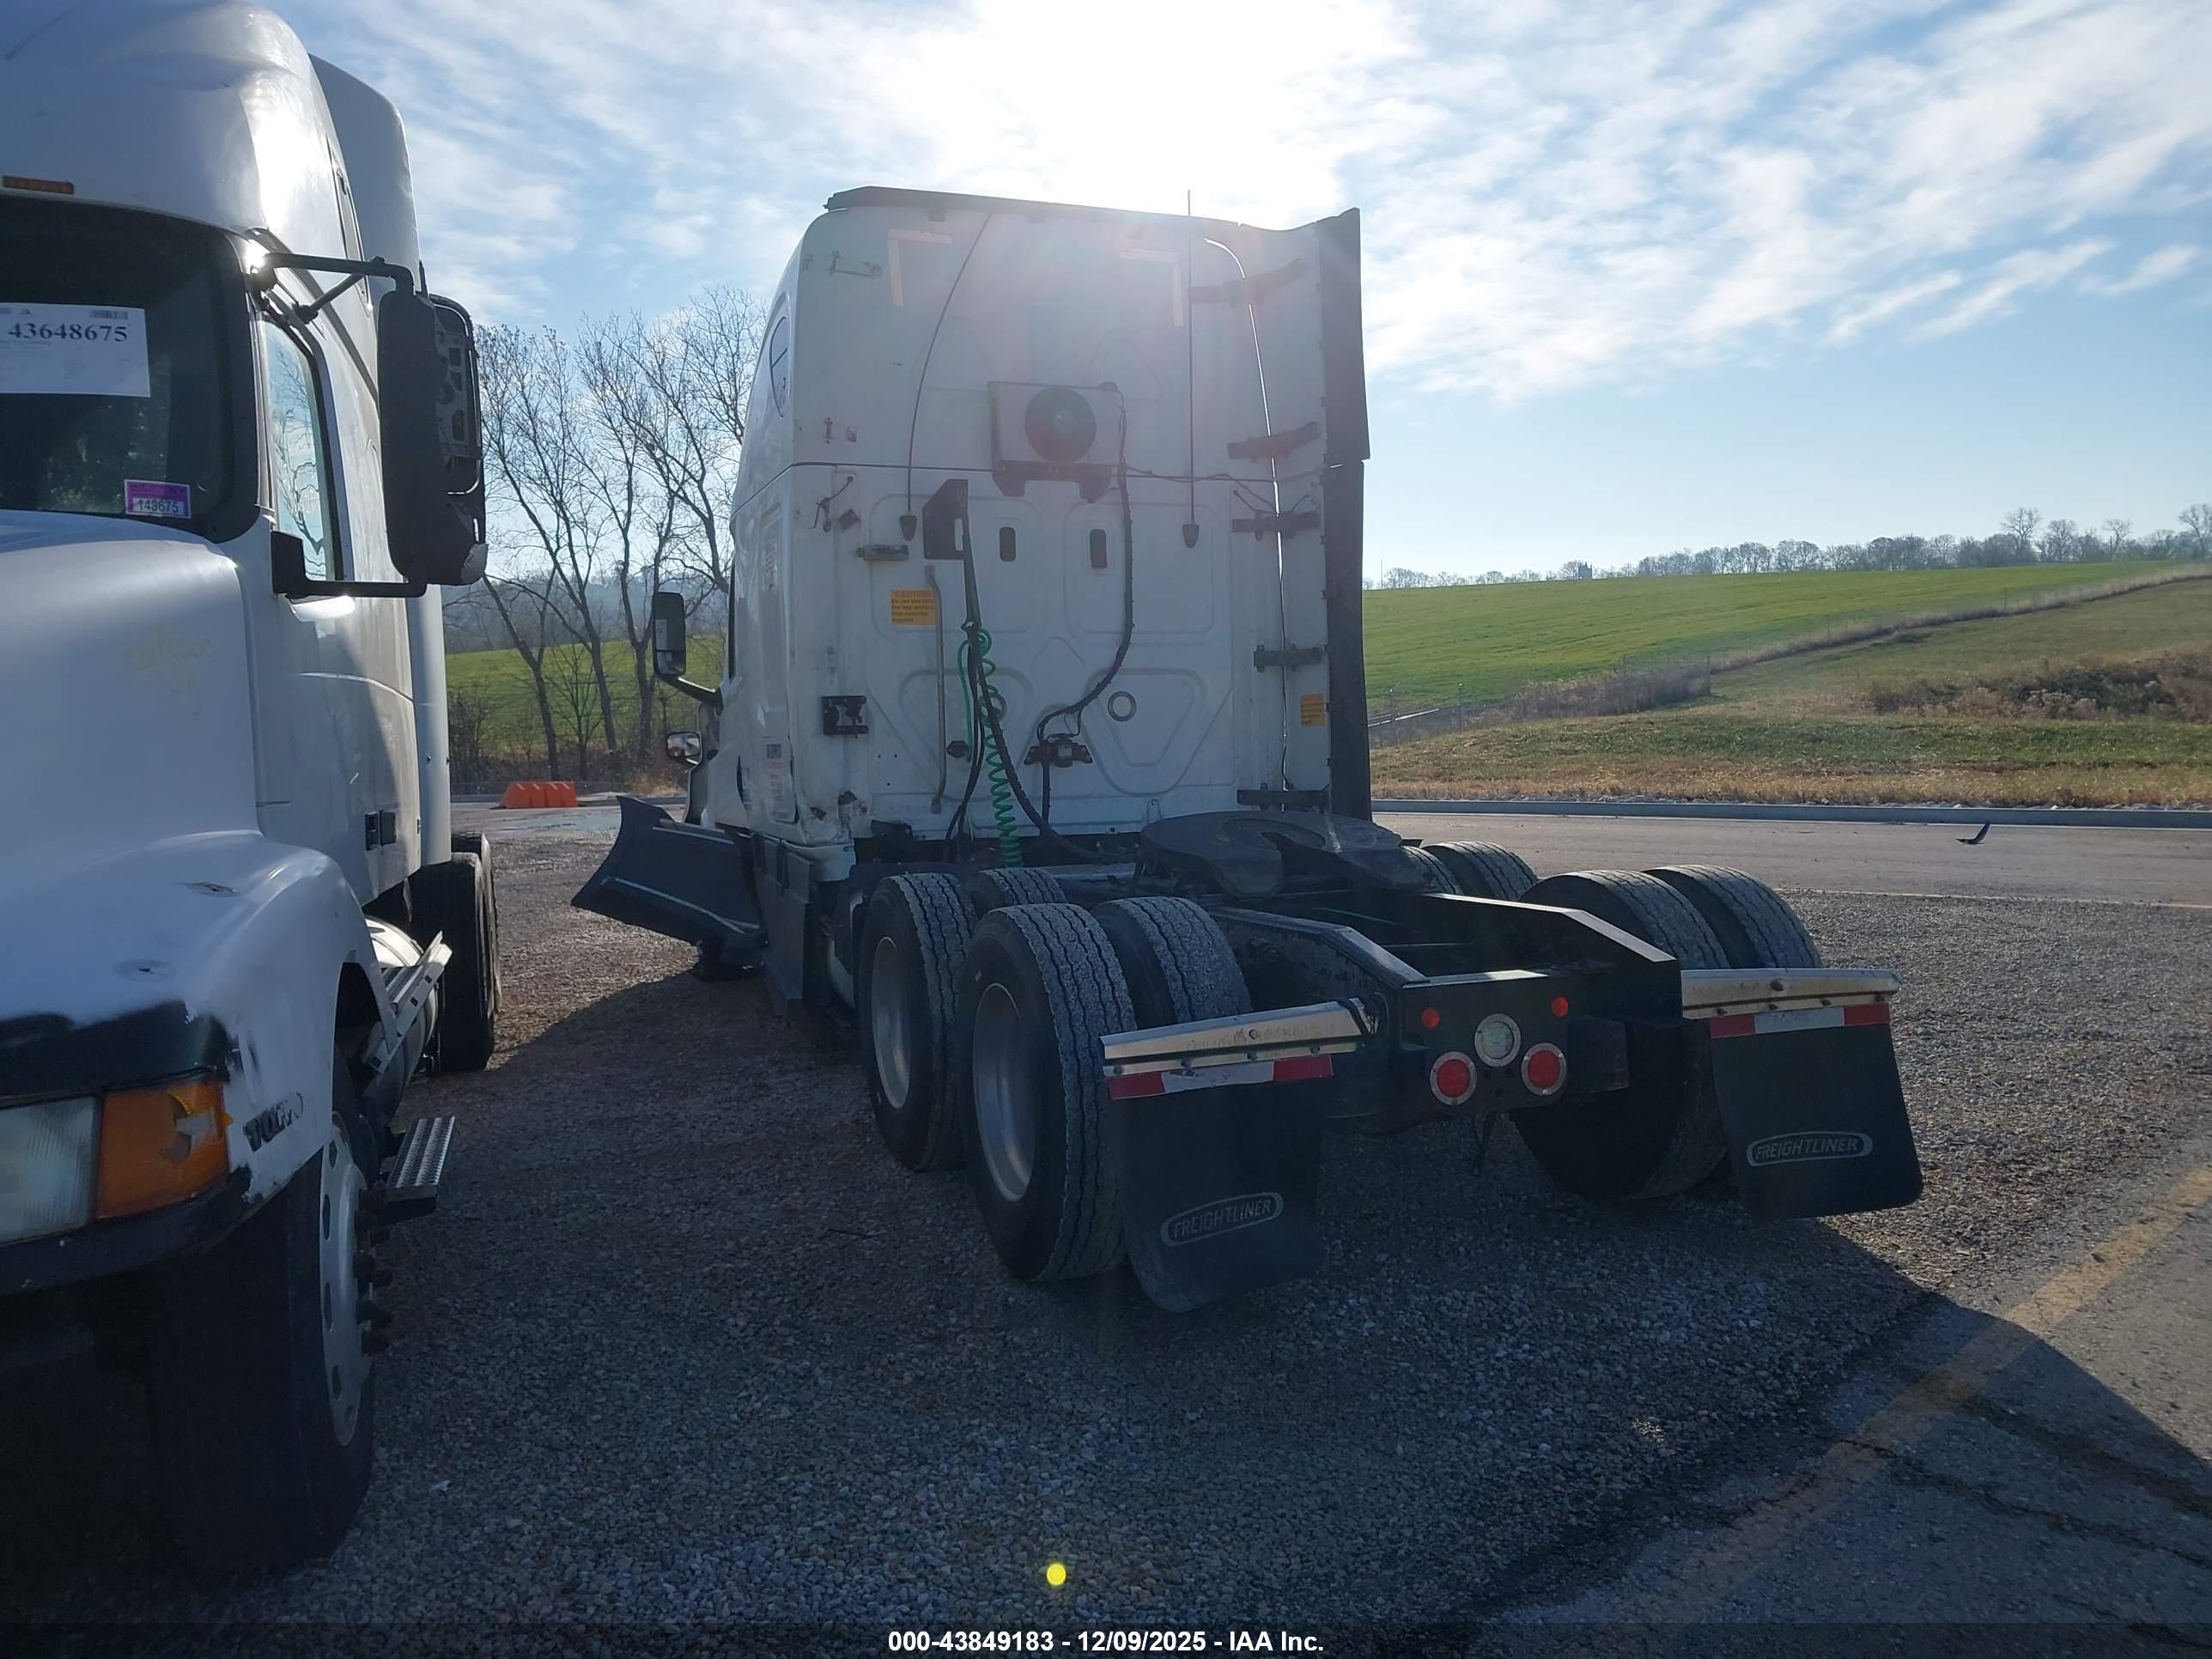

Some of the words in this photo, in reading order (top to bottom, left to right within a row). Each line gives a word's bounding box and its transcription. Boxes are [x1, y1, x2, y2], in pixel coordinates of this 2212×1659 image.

[8, 322, 128, 342] 43648675
[1756, 1138, 1858, 1160] FREIGHTLINER
[1174, 1199, 1273, 1239] FREIGHTLINER
